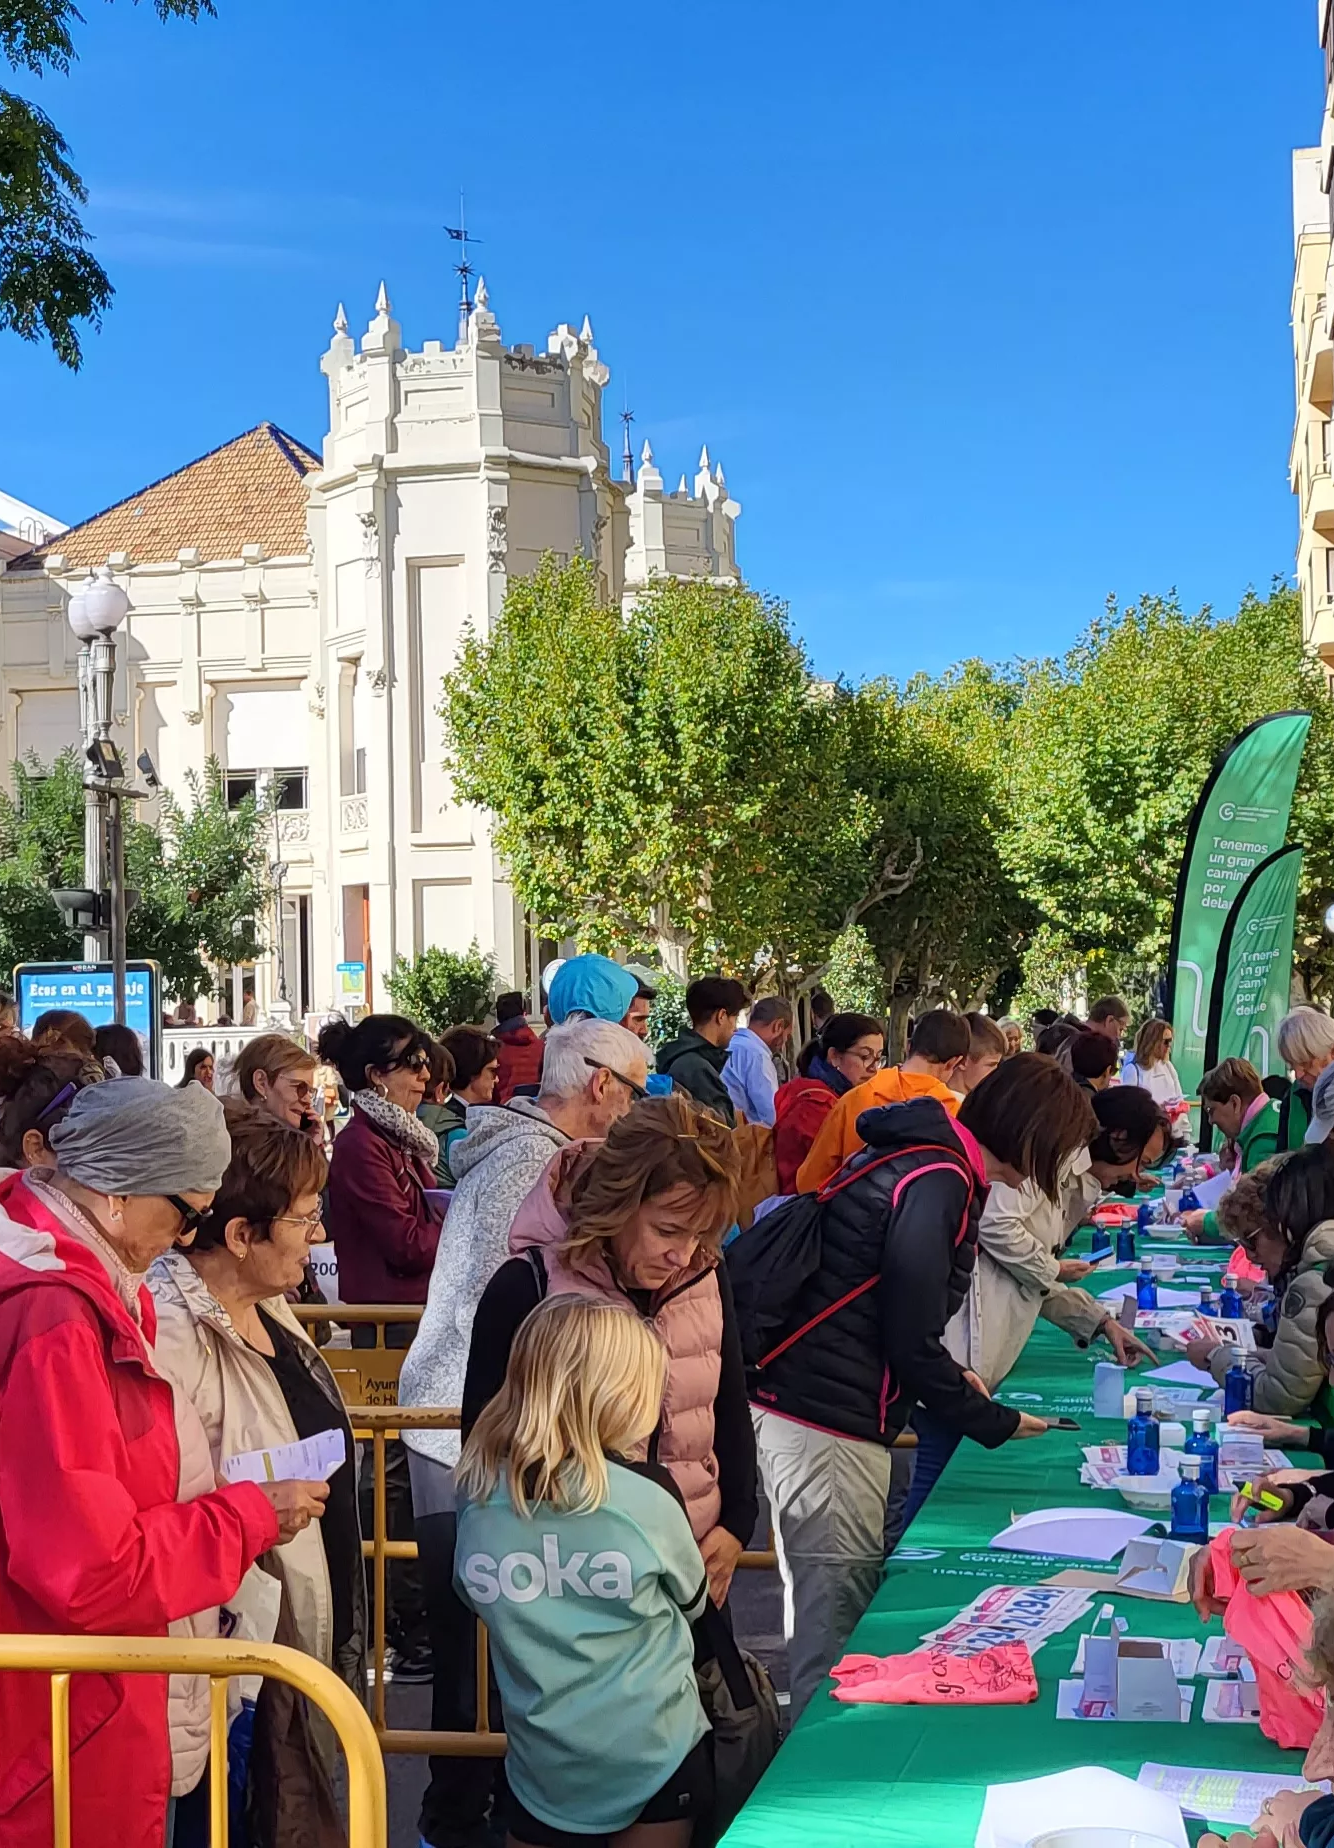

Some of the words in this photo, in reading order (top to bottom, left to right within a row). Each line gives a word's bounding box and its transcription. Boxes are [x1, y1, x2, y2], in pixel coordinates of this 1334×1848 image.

[1213, 837, 1268, 853] Tenemos
[1209, 853, 1224, 863] un
[1227, 855, 1255, 867] gran
[1203, 883, 1226, 894] por
[30, 984, 56, 996] Ecos
[61, 985, 76, 995] en
[81, 983, 92, 995] el
[1236, 993, 1257, 1004] por
[465, 1534, 634, 1604] soka
